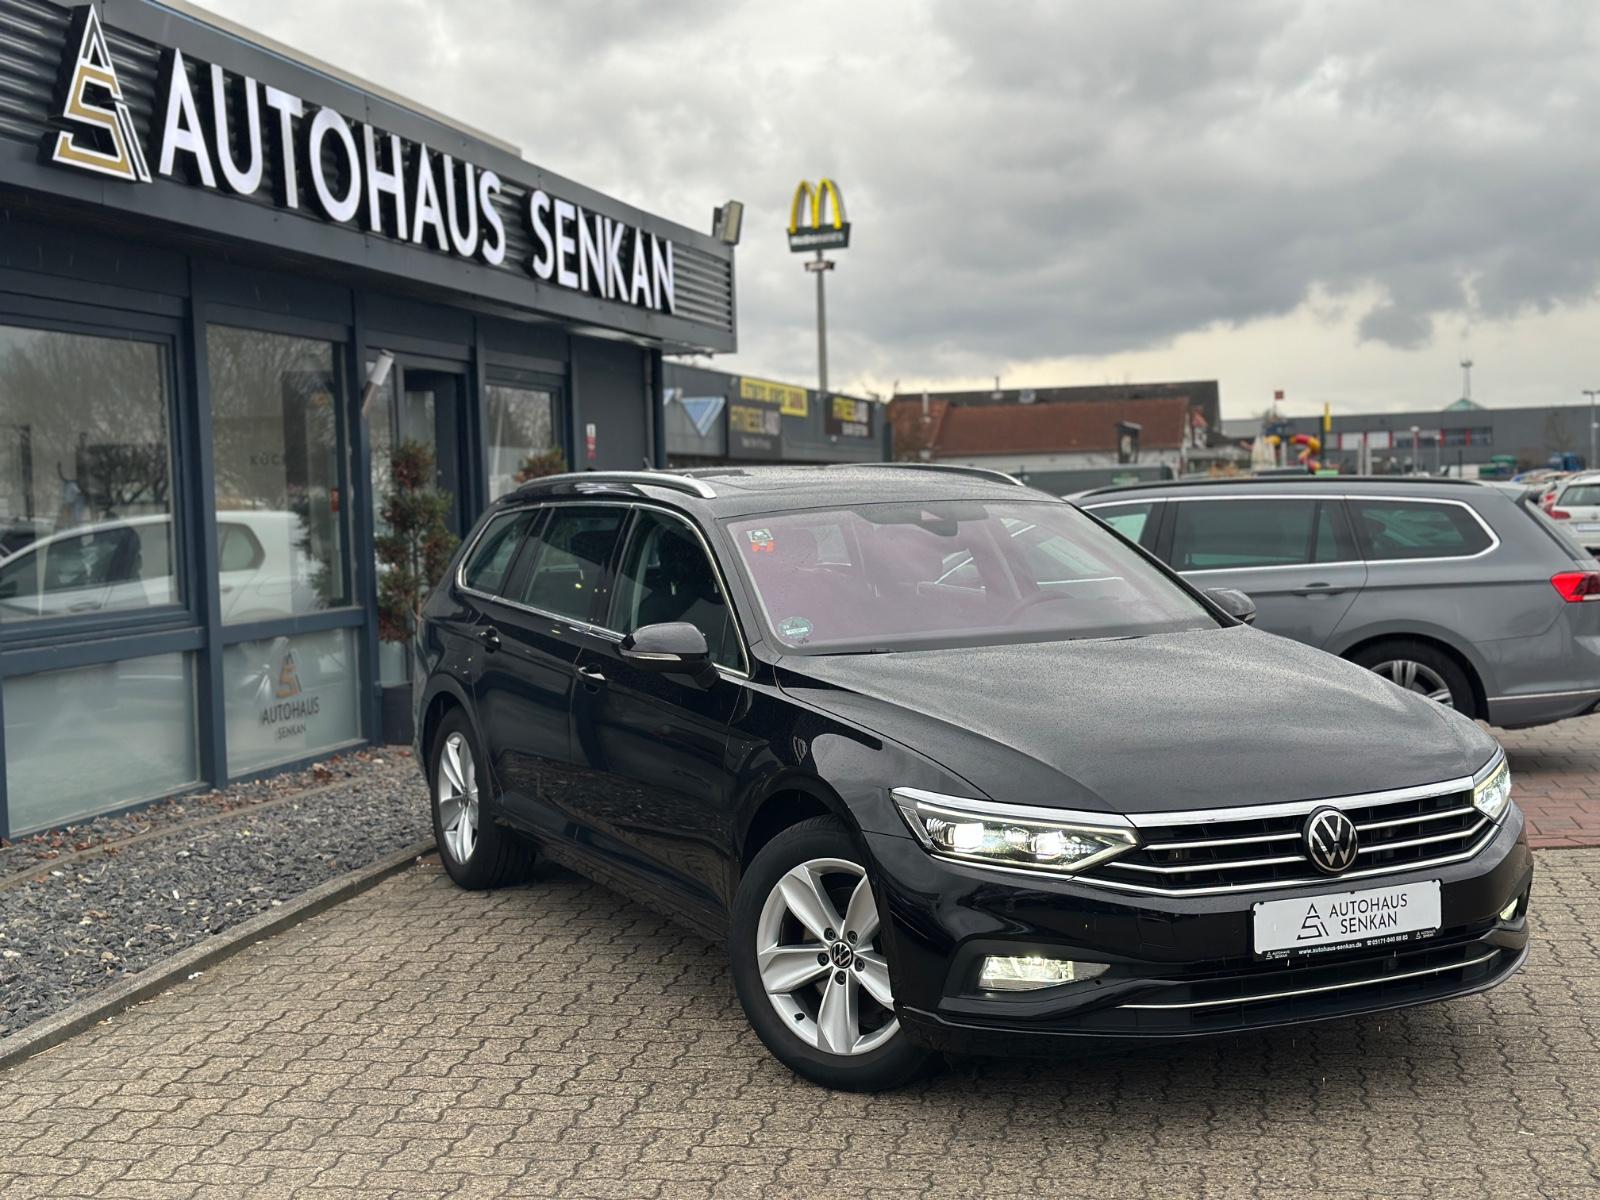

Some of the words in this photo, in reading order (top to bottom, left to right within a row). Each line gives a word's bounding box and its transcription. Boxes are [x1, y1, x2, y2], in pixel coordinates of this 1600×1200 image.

[159, 47, 506, 267] AUTOHAUS
[530, 190, 677, 315] SENKAN
[261, 695, 320, 726] AUTOHAUS
[277, 724, 307, 740] SENKAN
[1329, 893, 1408, 919] AUTOHAUS
[1340, 911, 1398, 935] SENKAN
[1298, 942, 1362, 955] www.autohaus-senkan.de
